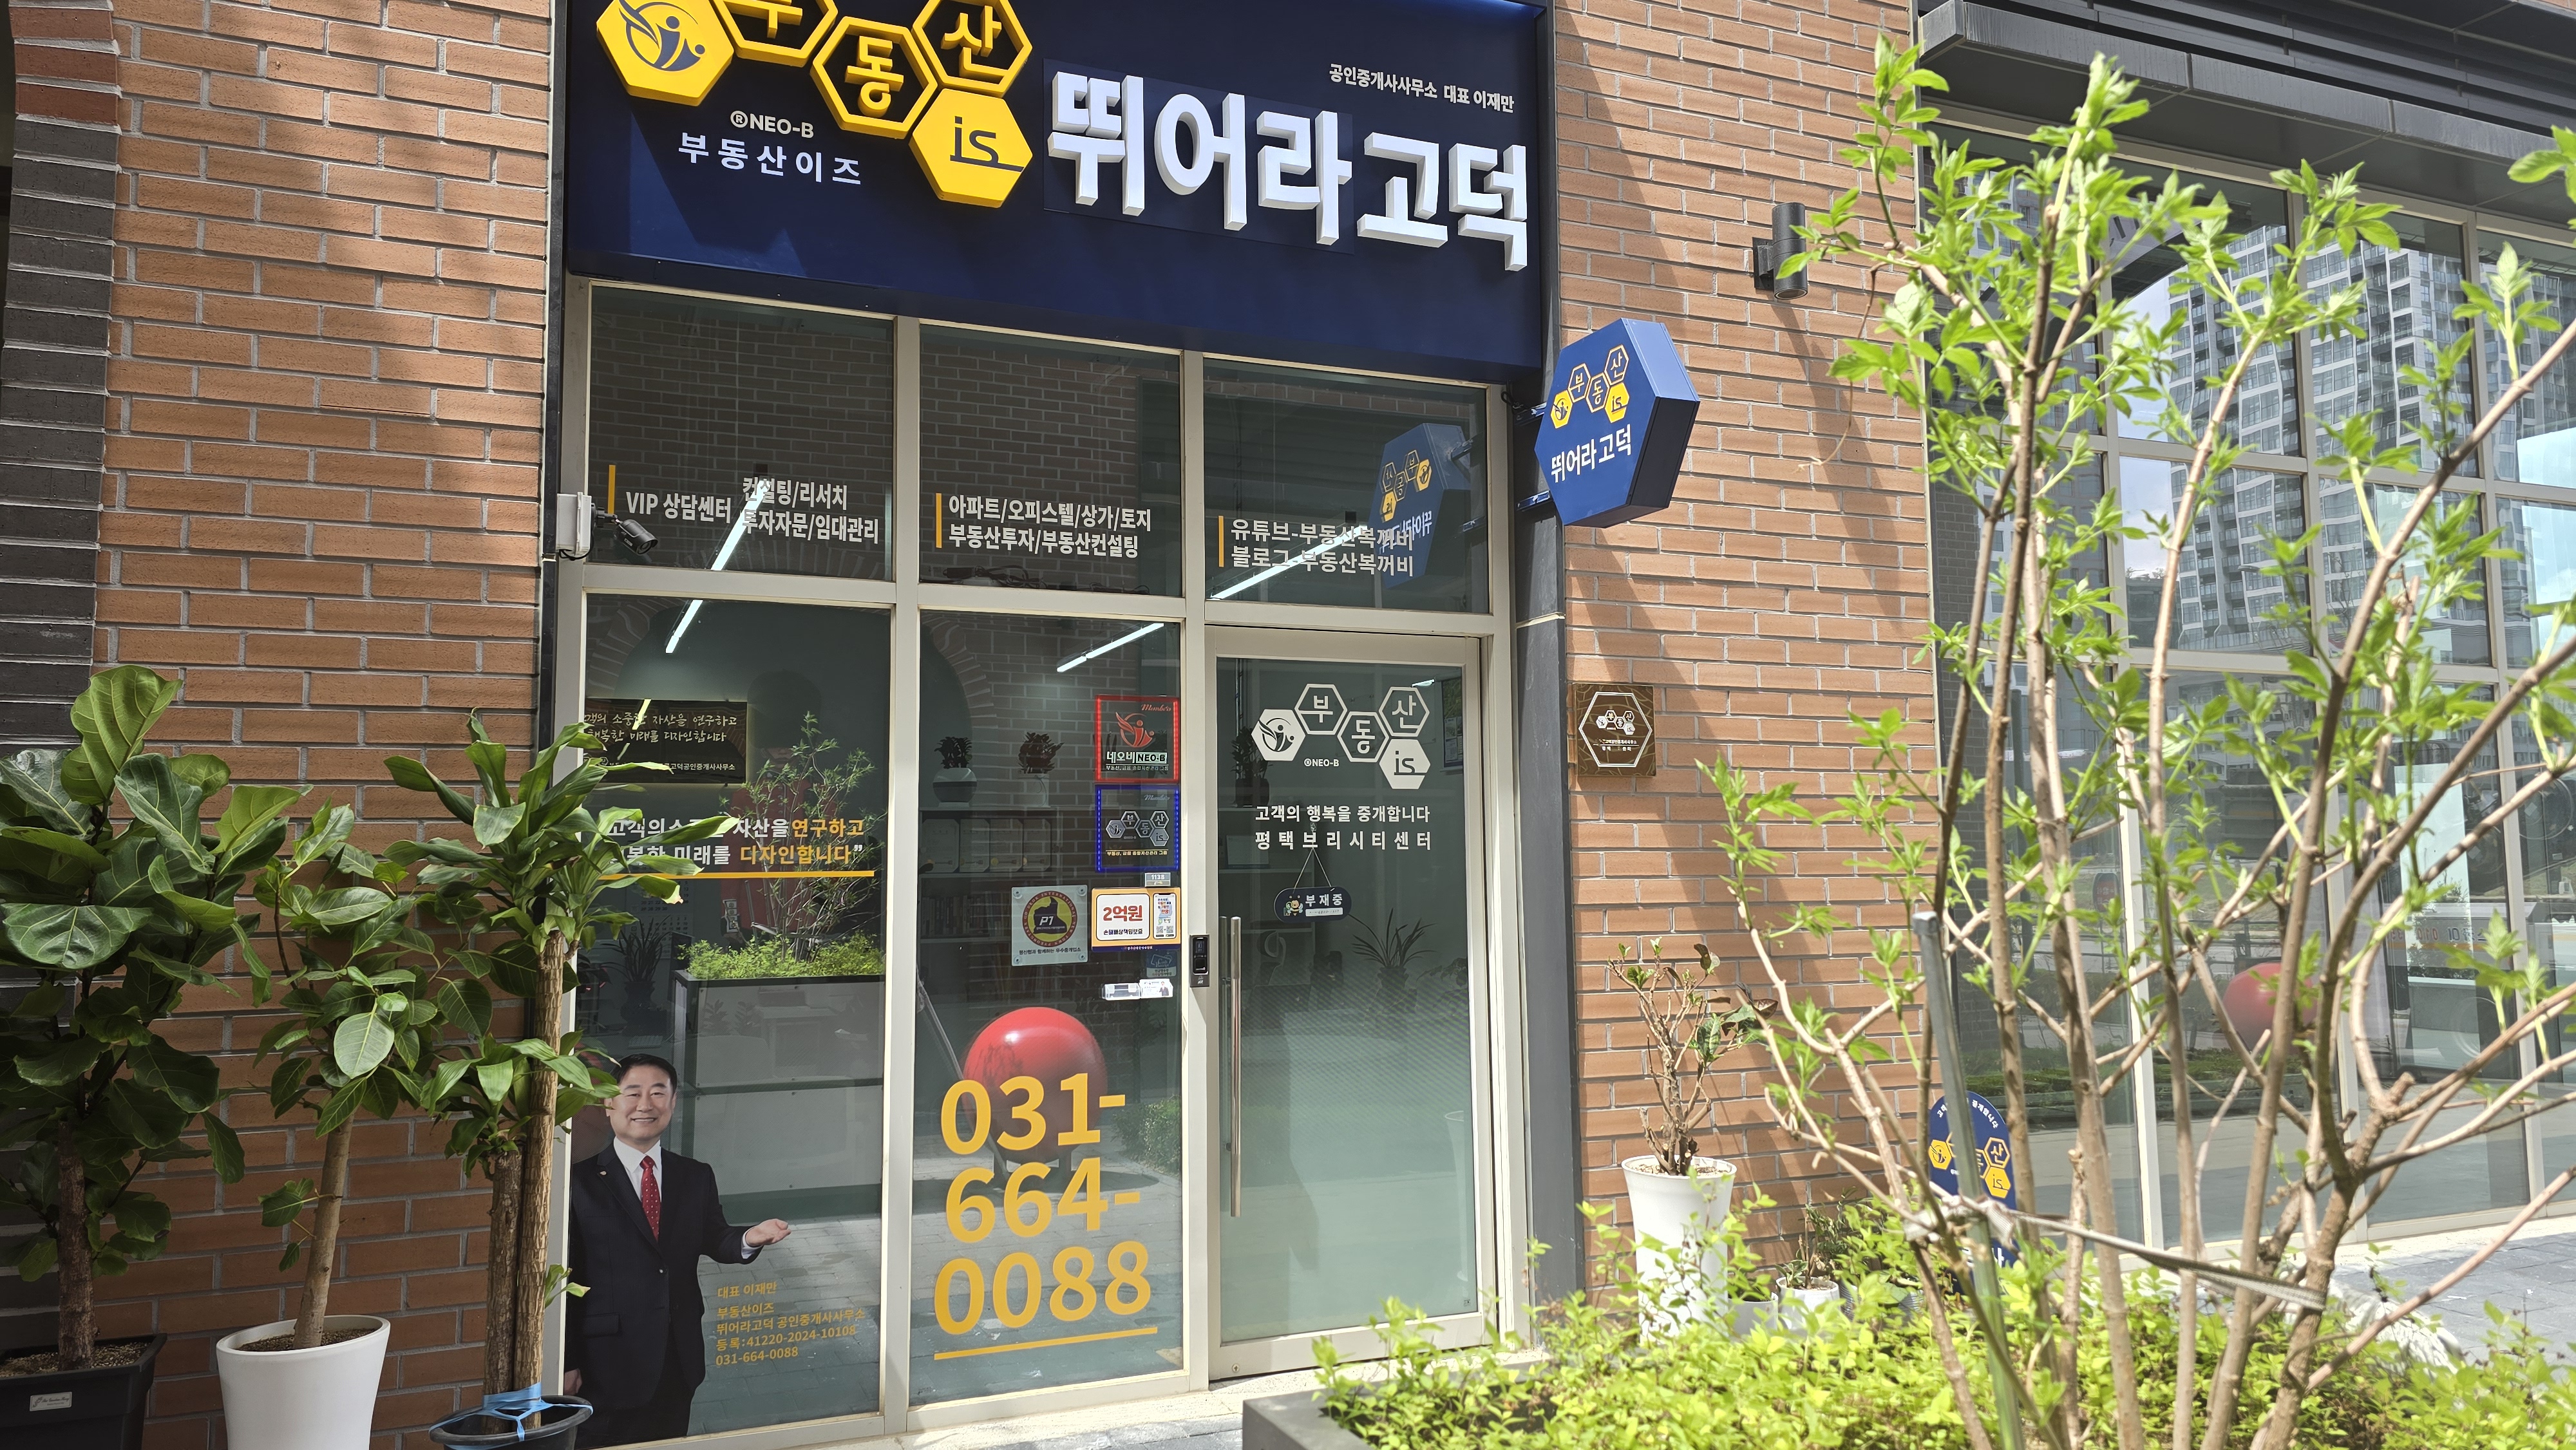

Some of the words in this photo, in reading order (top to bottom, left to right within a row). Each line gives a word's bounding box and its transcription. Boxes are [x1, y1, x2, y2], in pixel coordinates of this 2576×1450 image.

[1329, 63, 1437, 99] 공인중개사사무소
[1444, 85, 1470, 104] 대표
[1473, 90, 1514, 113] 이재만
[678, 132, 862, 185] 부동산이즈
[1048, 71, 1527, 272] 뛰어라고덕
[1551, 424, 1631, 483] 뛰어라고덕
[626, 491, 658, 515] VIP
[663, 493, 731, 524] 상담센터
[949, 495, 1151, 532] 아파트/오피스텔/상가/토지
[742, 510, 879, 545] 투자자문/임대관리
[949, 523, 1139, 558] 부동산투자/부동산컨설팅
[630, 730, 659, 743] 미래를
[664, 730, 727, 743] 디자인합니다
[653, 713, 687, 727] 자산을
[693, 714, 737, 727] 연구하고
[1106, 751, 1135, 764] 네오비
[1255, 805, 1300, 822] 고객의
[1306, 805, 1351, 823] 행복을
[1357, 805, 1430, 823] 중개합니다
[1103, 905, 1142, 921] 2억원
[1305, 894, 1343, 907] 부재중
[941, 1073, 1126, 1155] 031-
[945, 1156, 1141, 1243] 664-
[717, 1286, 740, 1299] 대표
[743, 1281, 777, 1296] 이재만
[934, 1240, 1151, 1335] 0088
[717, 1303, 775, 1319] 부동산이즈
[717, 1318, 773, 1335] 뛰어라고덕
[776, 1308, 866, 1329] 공인중개사사무소
[715, 1346, 799, 1366] 031-664-0088
